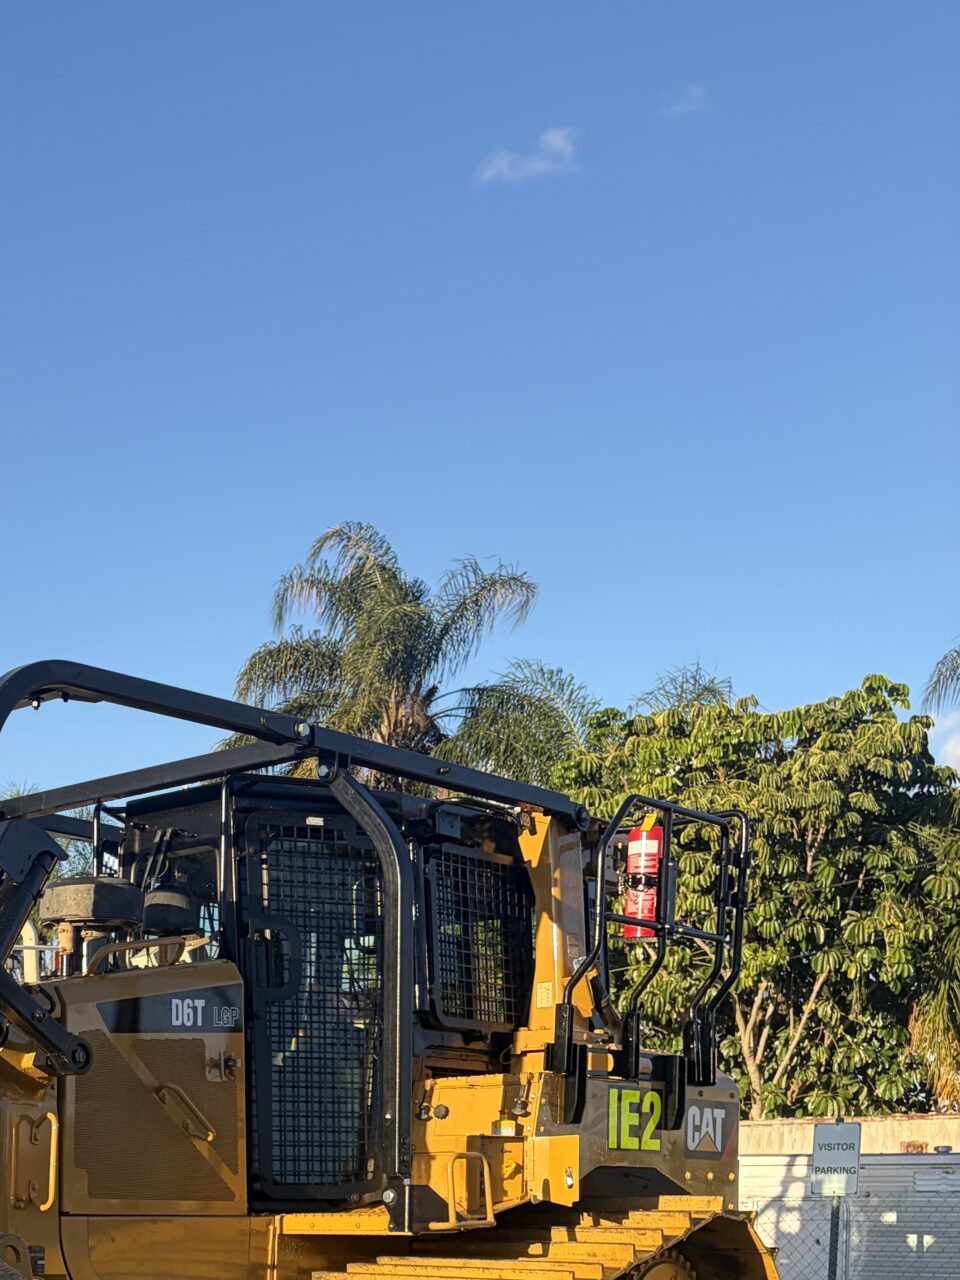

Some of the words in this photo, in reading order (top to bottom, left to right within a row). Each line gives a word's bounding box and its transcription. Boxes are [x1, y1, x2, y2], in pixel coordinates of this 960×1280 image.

[171, 999, 206, 1026] D6T
[213, 1007, 239, 1027] LGP
[608, 1088, 661, 1151] IE2
[687, 1105, 726, 1153] CAT
[818, 1142, 856, 1152] VISITOR
[814, 1166, 857, 1175] PARKING
